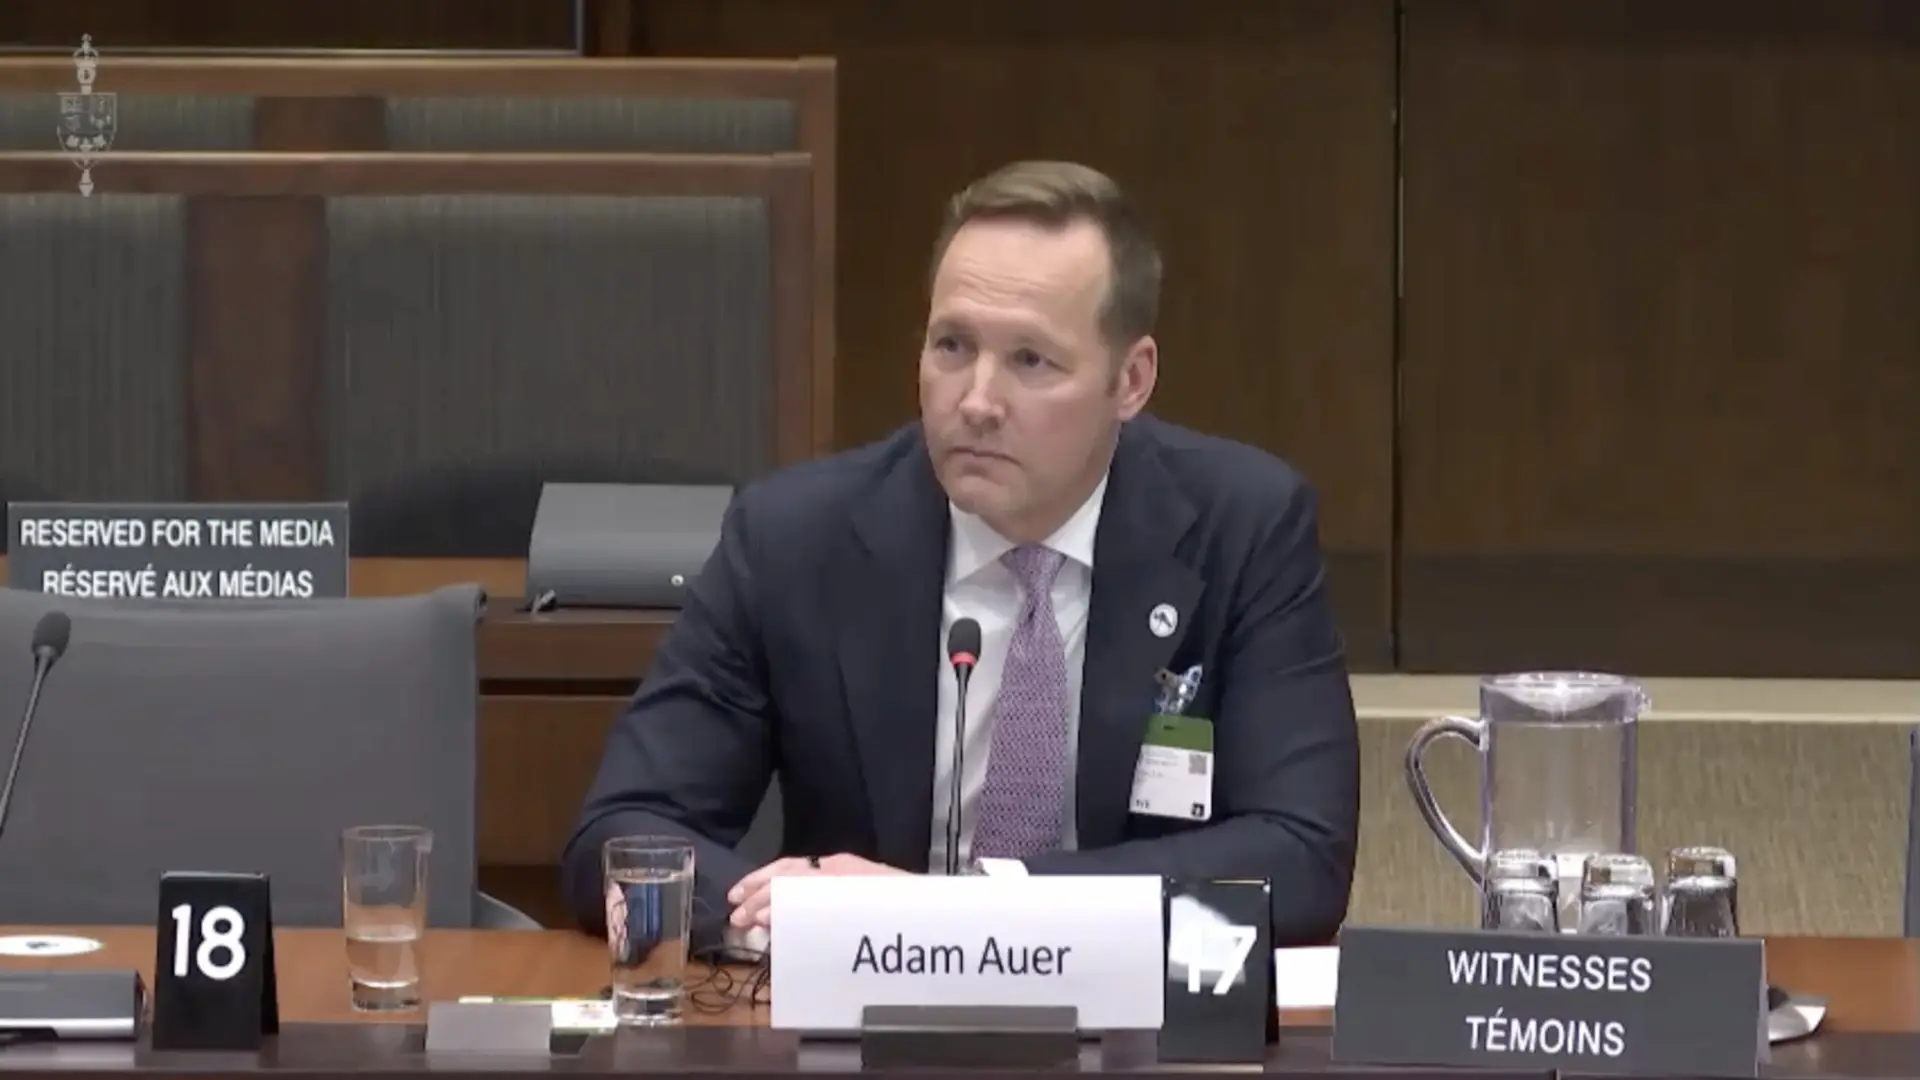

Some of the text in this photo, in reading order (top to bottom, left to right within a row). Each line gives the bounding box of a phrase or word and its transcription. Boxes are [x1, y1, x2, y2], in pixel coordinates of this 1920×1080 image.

[20, 519, 335, 547] RESERVED FOR THE MEDIA
[43, 563, 313, 598] RÉSERVÉ AUX MÉDIAS
[172, 903, 246, 980] 18
[851, 933, 1072, 976] Adam Auer
[1447, 950, 1653, 993] WITNESSES
[1465, 1007, 1625, 1057] TÉMOINS
